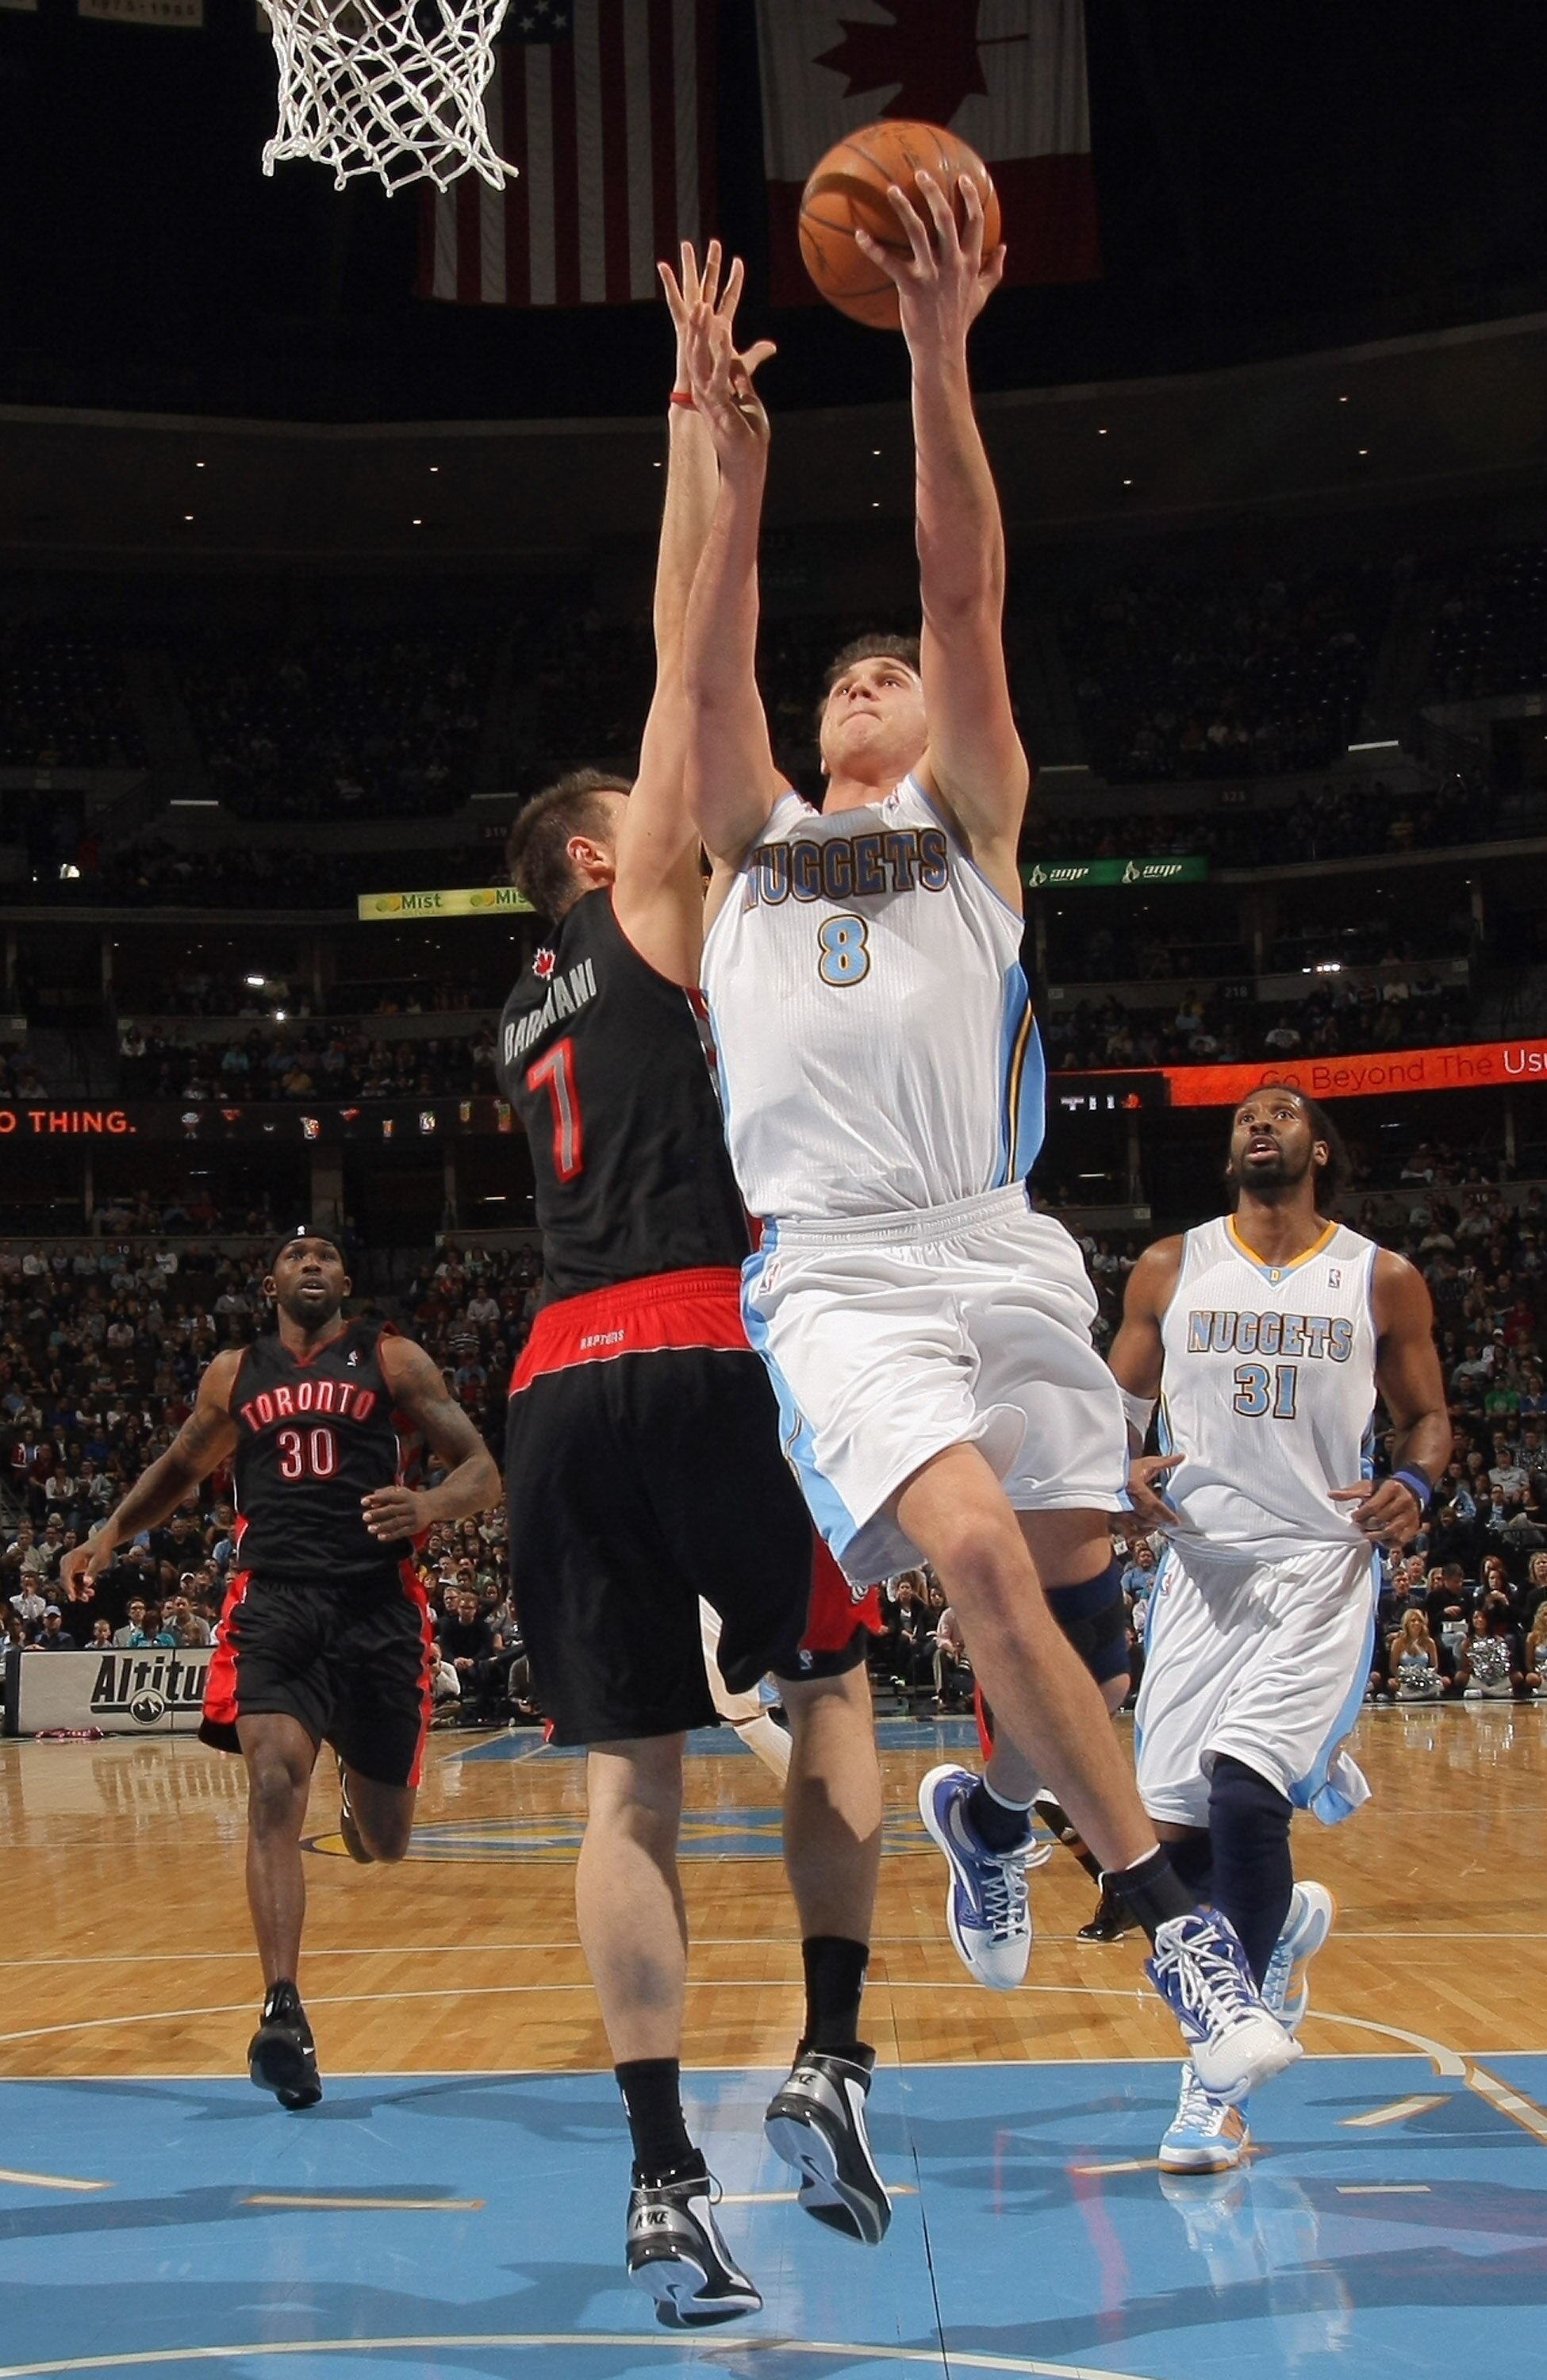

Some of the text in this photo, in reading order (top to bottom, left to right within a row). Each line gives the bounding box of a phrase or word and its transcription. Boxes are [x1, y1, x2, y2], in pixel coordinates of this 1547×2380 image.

[402, 893, 443, 909] Mist
[818, 914, 870, 987] 8
[1312, 1058, 1424, 1091] Beyond
[1437, 1054, 1493, 1077] The
[29, 1111, 136, 1133] THING.
[526, 1036, 583, 1184] 7
[1188, 1311, 1353, 1362] NUGGETS
[240, 1379, 377, 1432] TORONTO
[1234, 1363, 1297, 1419] 31
[278, 1428, 336, 1480] 30
